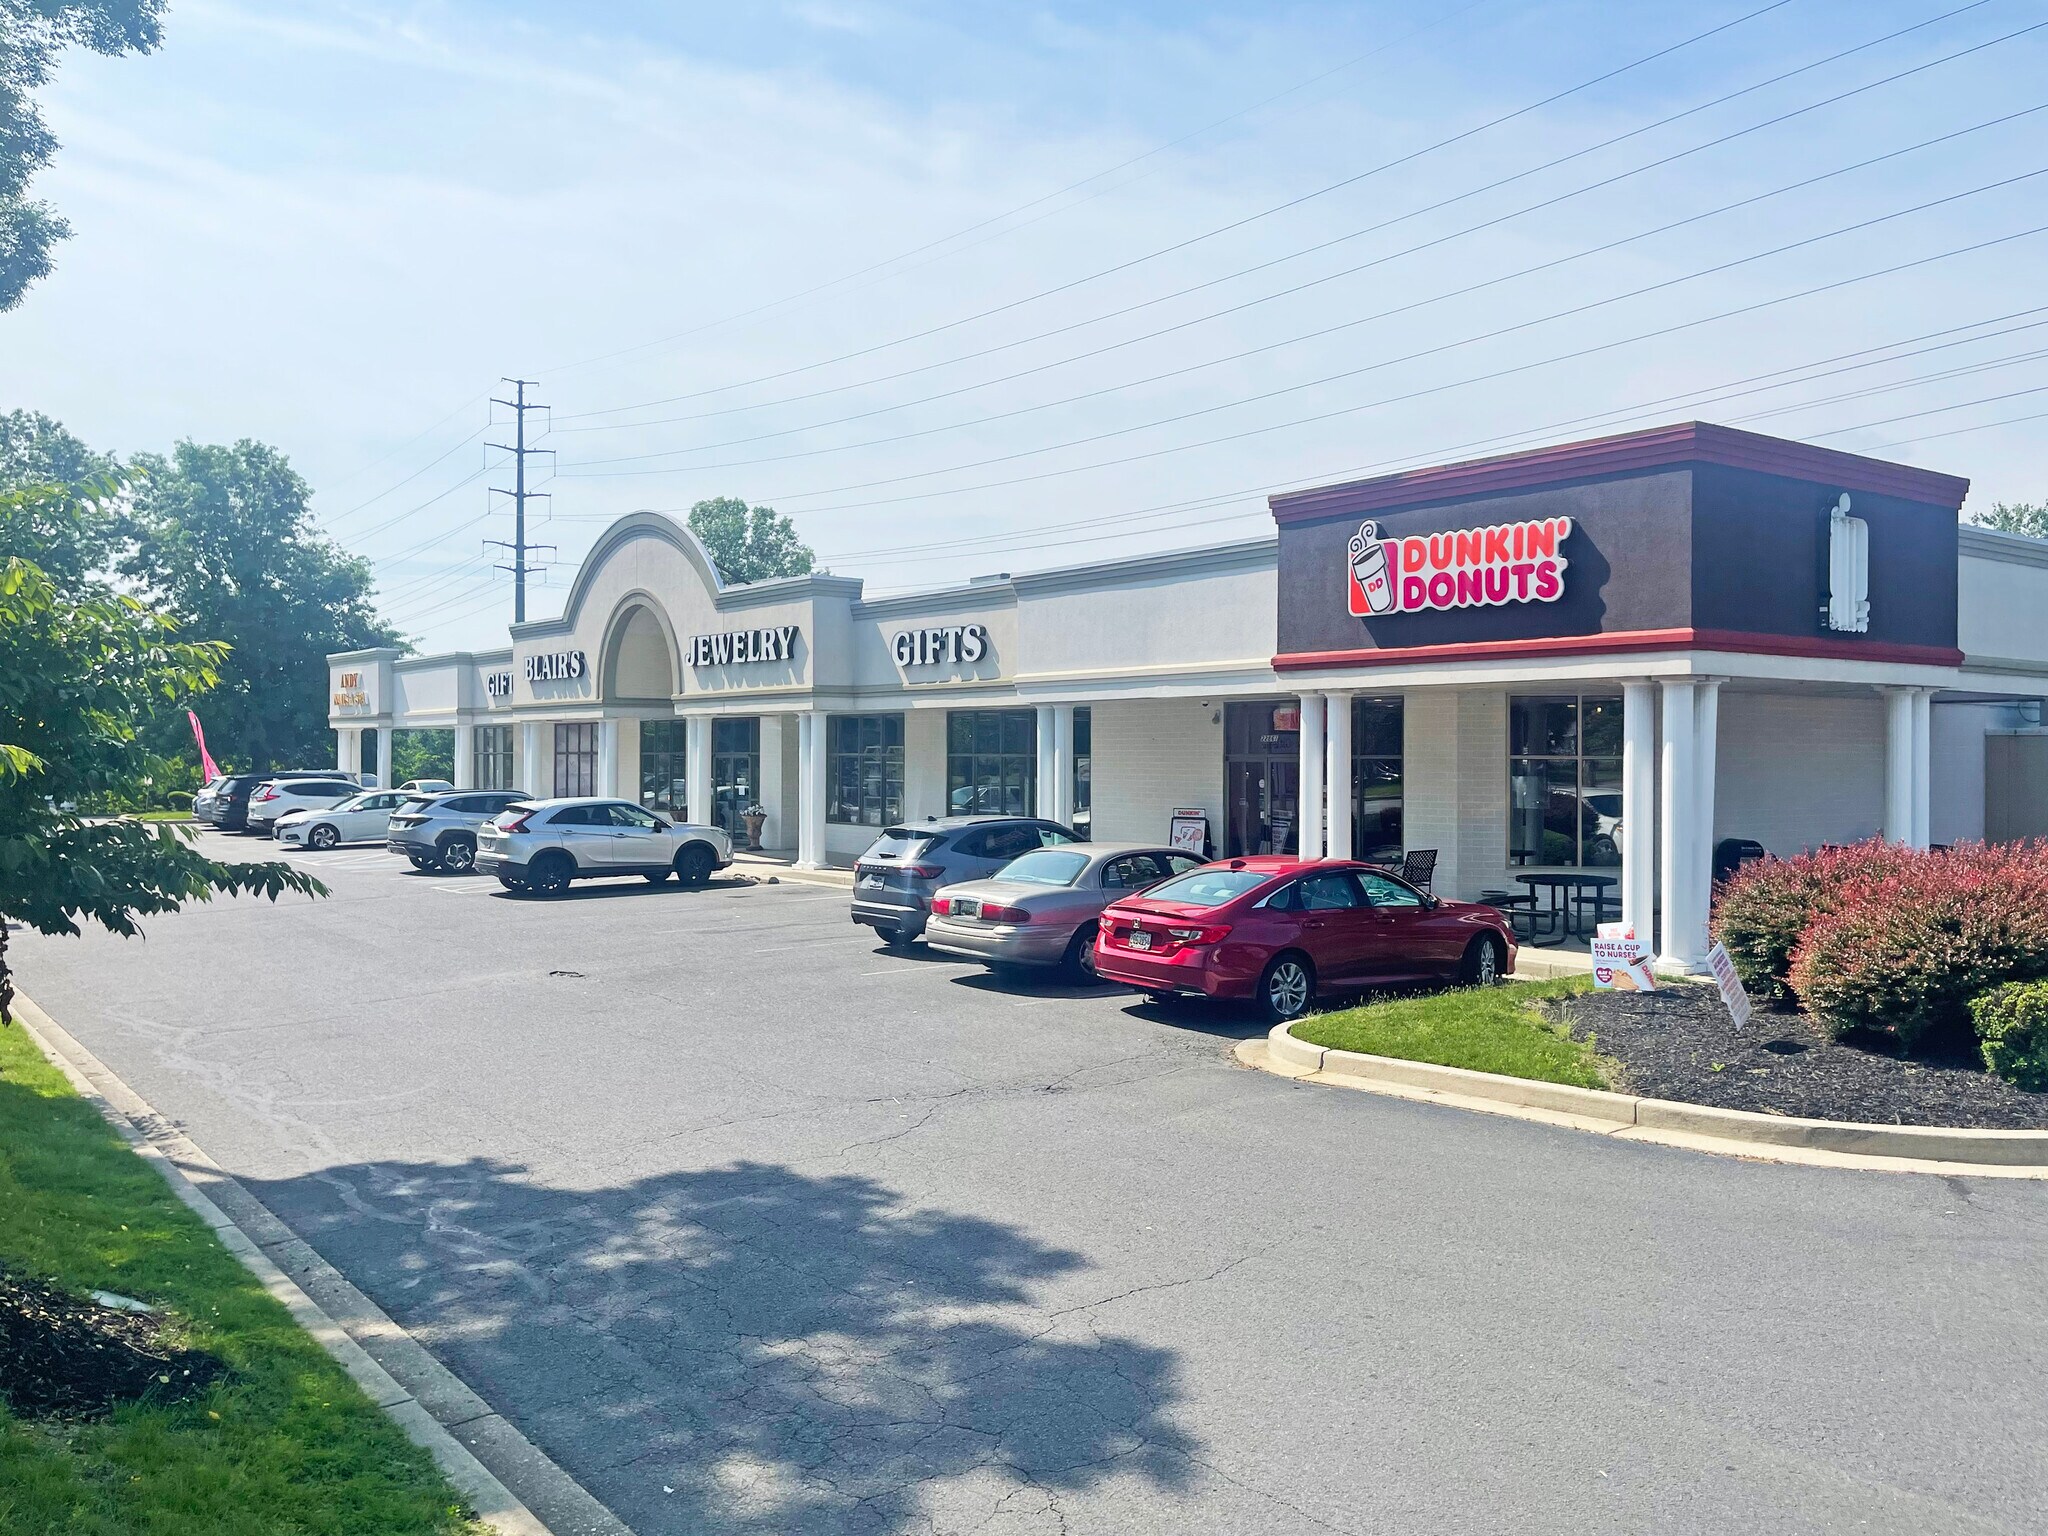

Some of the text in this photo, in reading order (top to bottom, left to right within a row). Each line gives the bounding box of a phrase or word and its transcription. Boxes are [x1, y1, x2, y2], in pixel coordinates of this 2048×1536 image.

[1403, 519, 1568, 573] DUNKIN'
[1367, 577, 1384, 593] DD
[1402, 560, 1560, 609] DONUTS
[524, 625, 797, 681] BLAIR'S JEWELRY
[890, 624, 986, 667] GIFTS
[340, 672, 359, 688] ANDY
[1594, 942, 1641, 952] RAISE A CUP
[1594, 950, 1637, 959] TO NURSES
